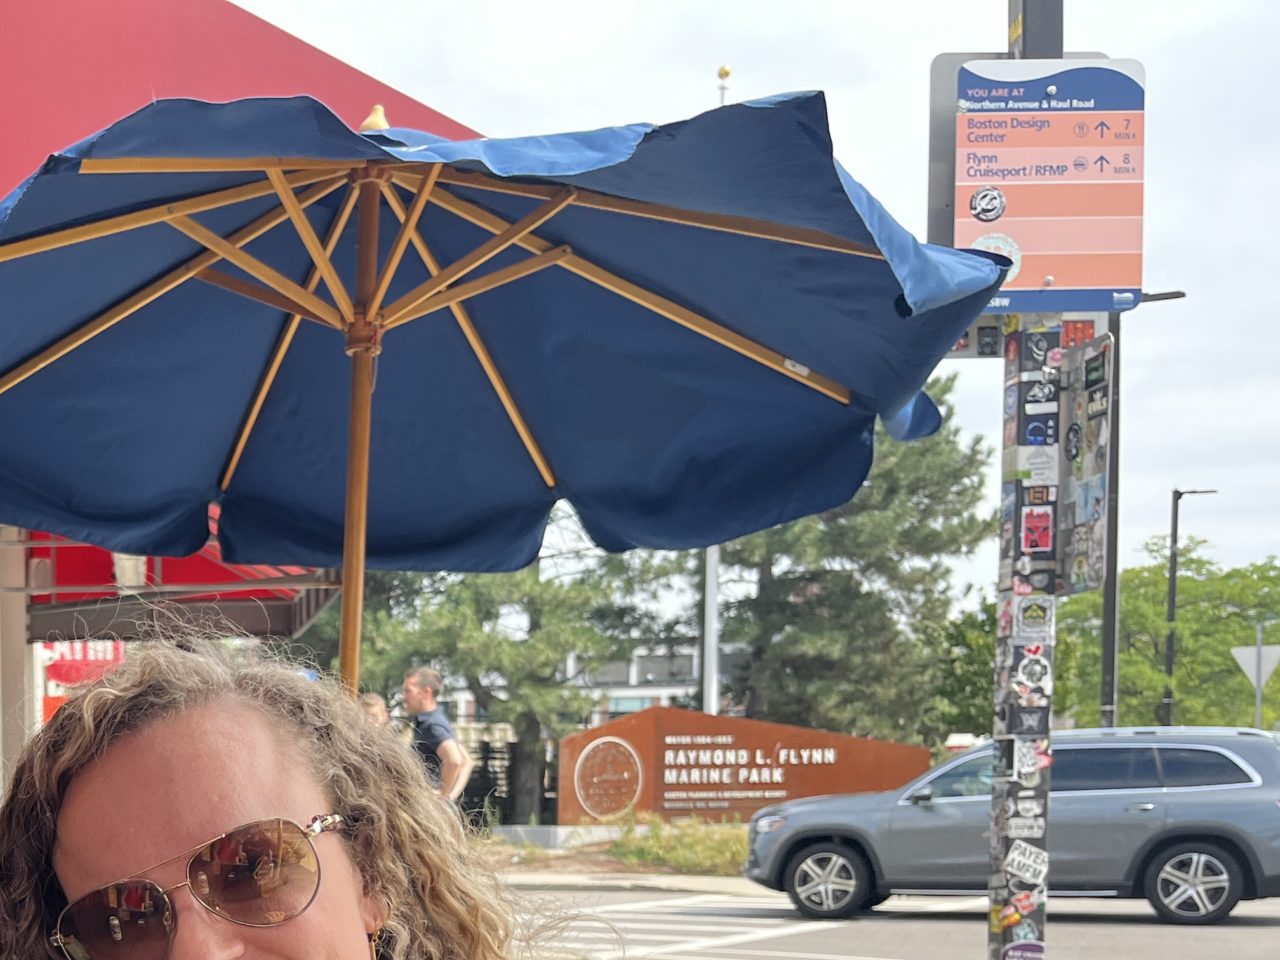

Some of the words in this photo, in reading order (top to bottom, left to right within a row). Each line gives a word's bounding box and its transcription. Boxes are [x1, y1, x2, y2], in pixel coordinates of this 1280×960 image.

[966, 88, 988, 97] YOU
[990, 88, 1009, 97] ARE
[1011, 87, 1025, 97] AT
[966, 99, 1006, 110] Northern
[1007, 99, 1040, 109] Avenue
[1041, 99, 1049, 109] &
[1050, 98, 1070, 109] Haul
[1071, 98, 1095, 109] Road
[967, 118, 1007, 129] Boston
[1010, 117, 1050, 131] Design
[1123, 118, 1131, 130] 7
[967, 131, 1006, 143] Center
[966, 152, 997, 166] Flynn
[1123, 153, 1130, 165] 8
[966, 165, 1027, 179] Cruiseport
[1035, 164, 1068, 176] RFMP
[53, 640, 114, 661] ATM
[664, 748, 750, 765] RAYMOND
[755, 748, 772, 765] L.
[779, 747, 836, 764] FLYNN
[663, 767, 734, 784] MARINE
[738, 767, 785, 784] PARK
